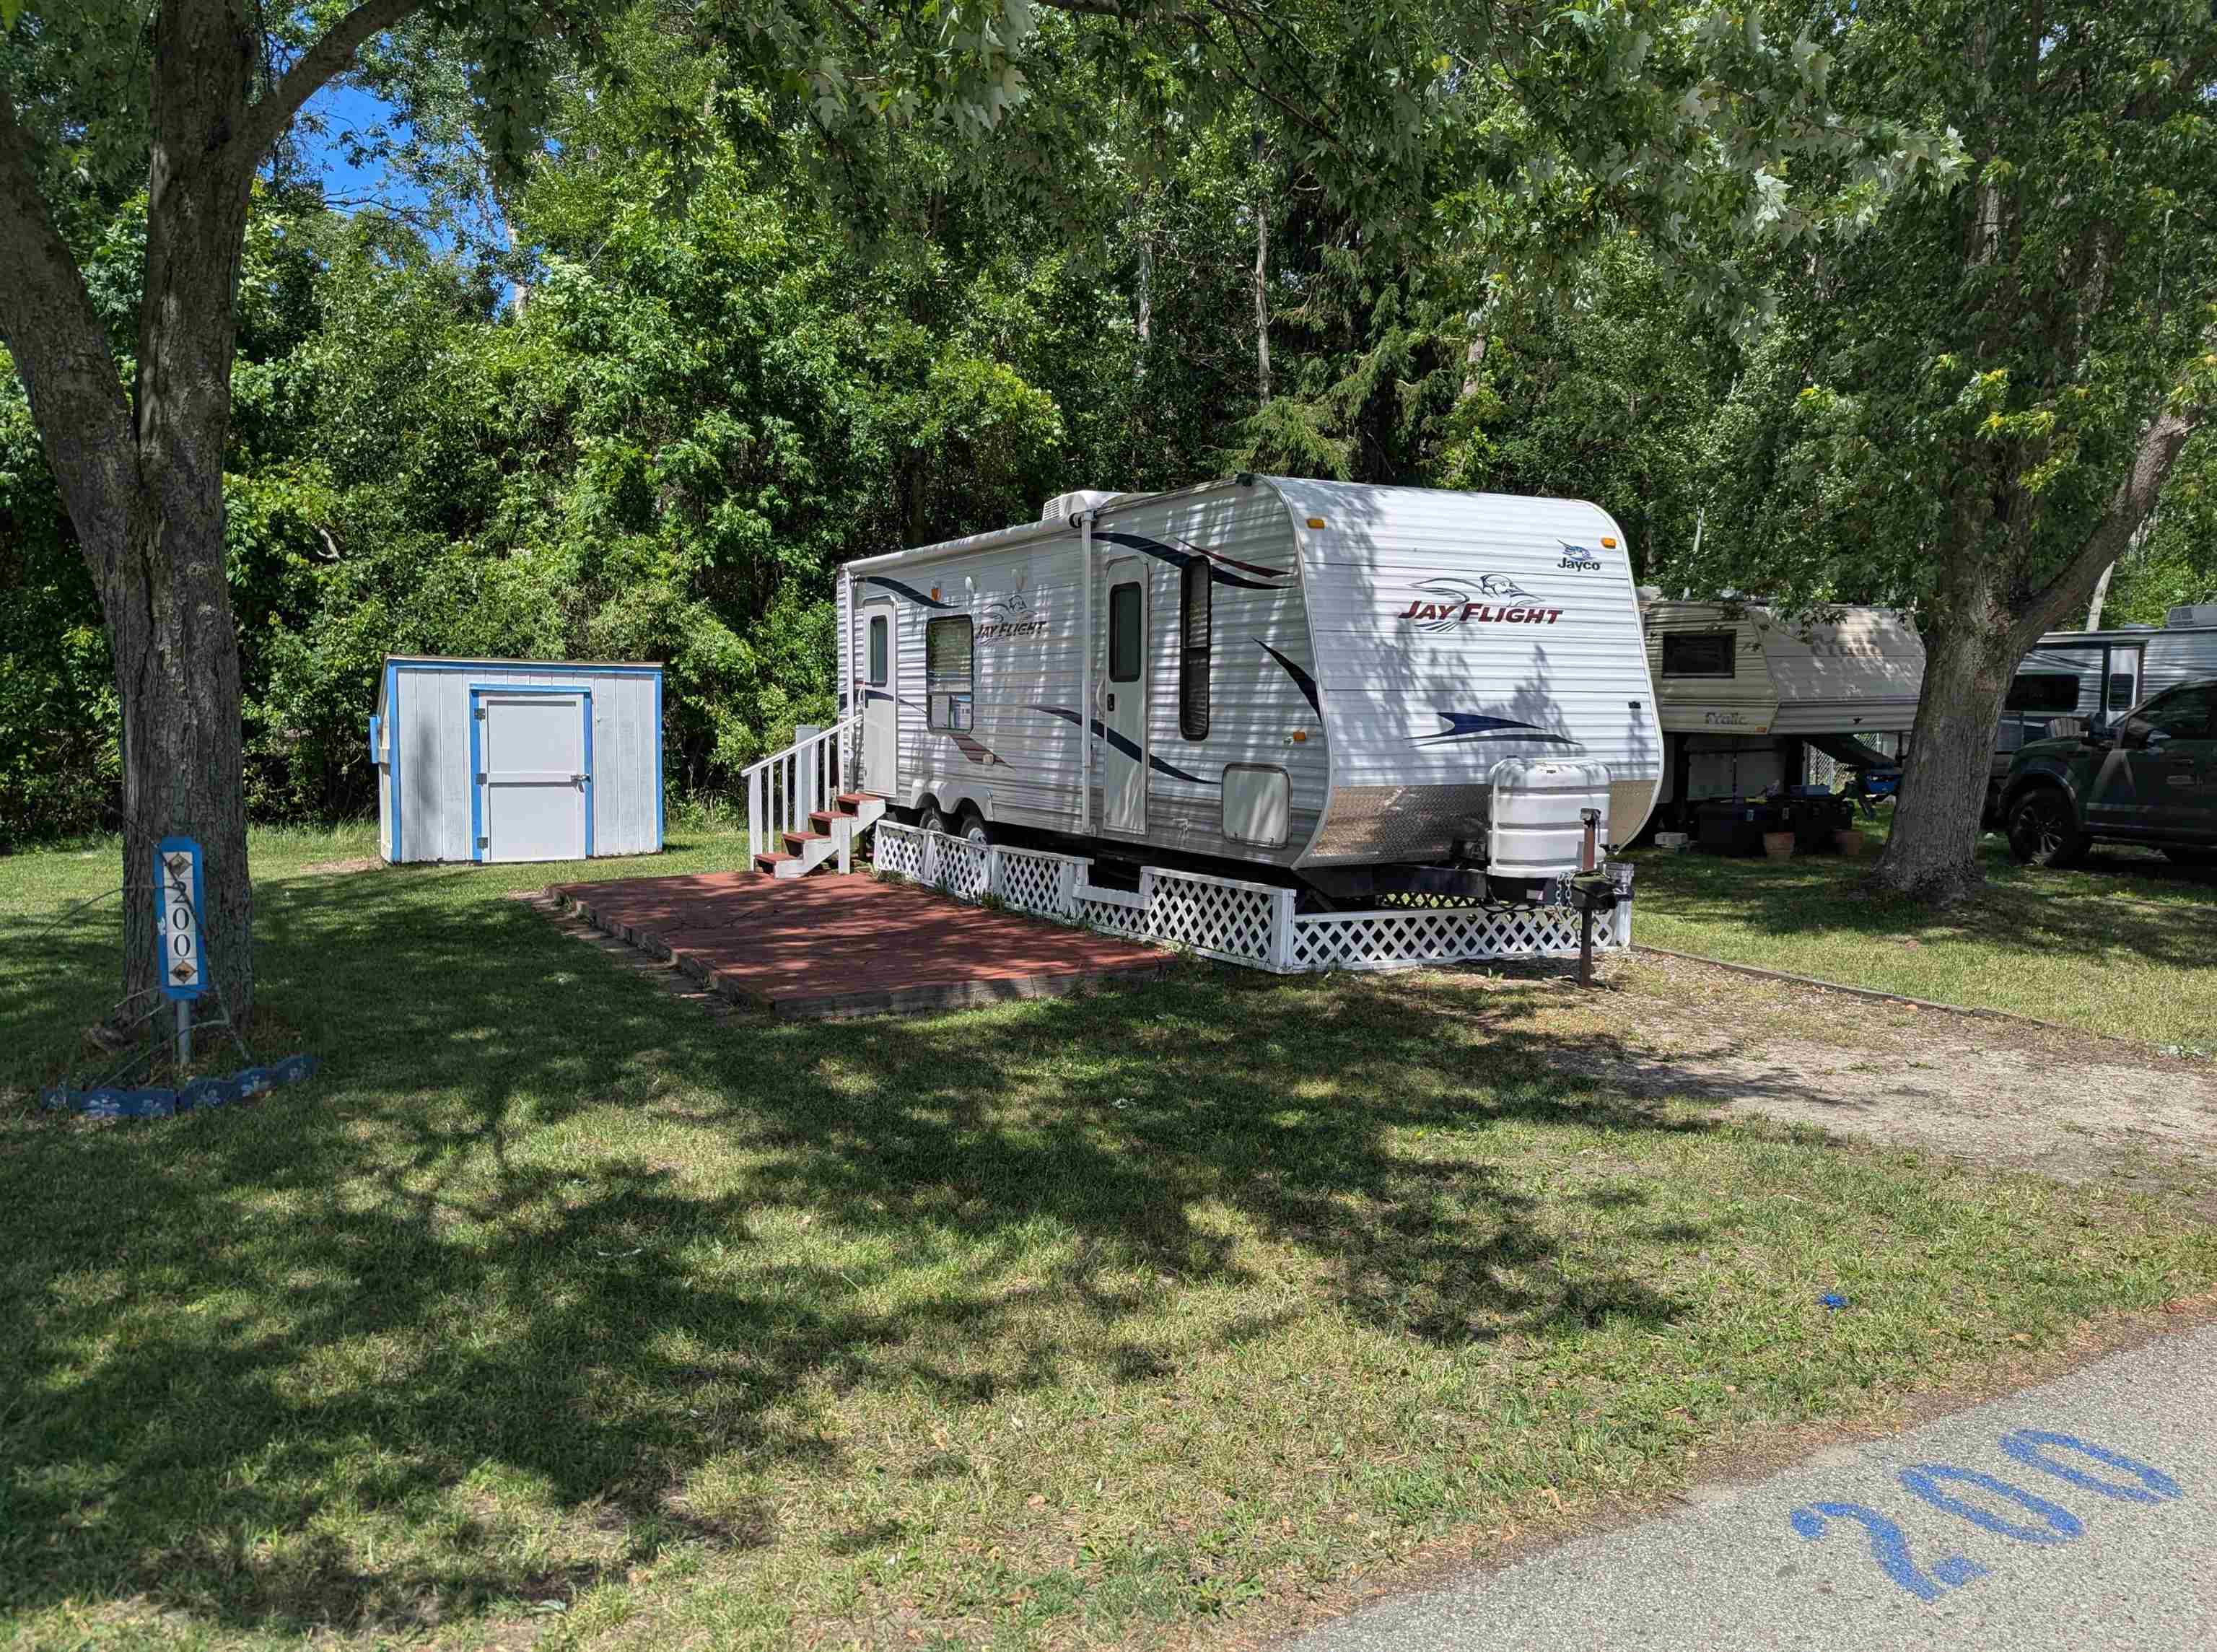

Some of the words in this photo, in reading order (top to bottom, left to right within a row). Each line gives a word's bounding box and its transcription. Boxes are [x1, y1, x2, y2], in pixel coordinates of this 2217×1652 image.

[1557, 557, 1601, 572] Jayco
[1398, 600, 1456, 621] JAY
[1459, 603, 1564, 624] FLIGHT
[172, 880, 191, 957] 200
[1790, 1428, 2184, 1604] 200
